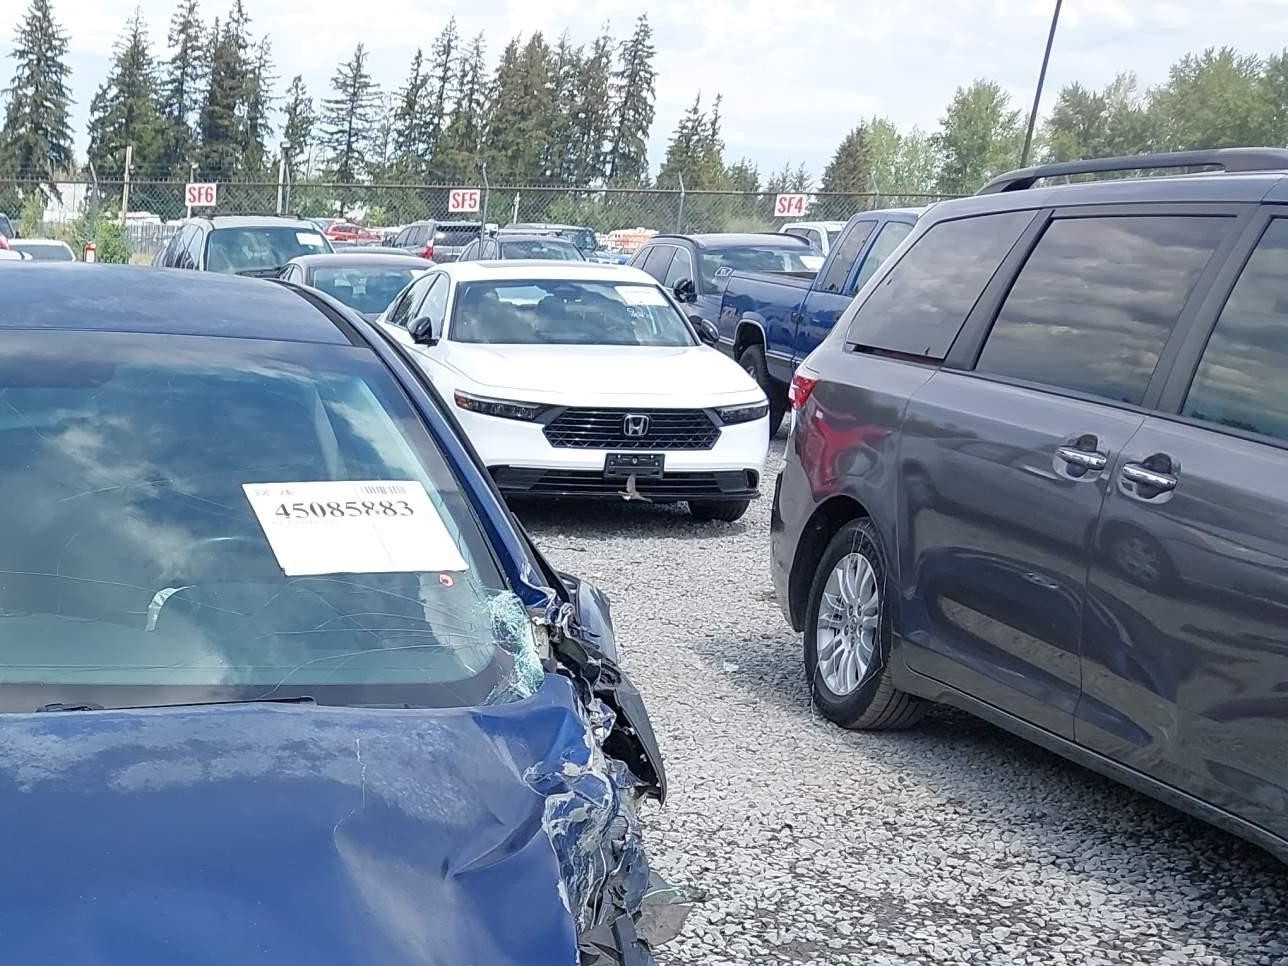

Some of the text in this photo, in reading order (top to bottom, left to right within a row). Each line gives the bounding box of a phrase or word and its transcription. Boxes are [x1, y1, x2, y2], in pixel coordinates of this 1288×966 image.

[188, 186, 214, 203] SF6
[452, 191, 477, 208] SF5
[777, 196, 803, 213] SF4
